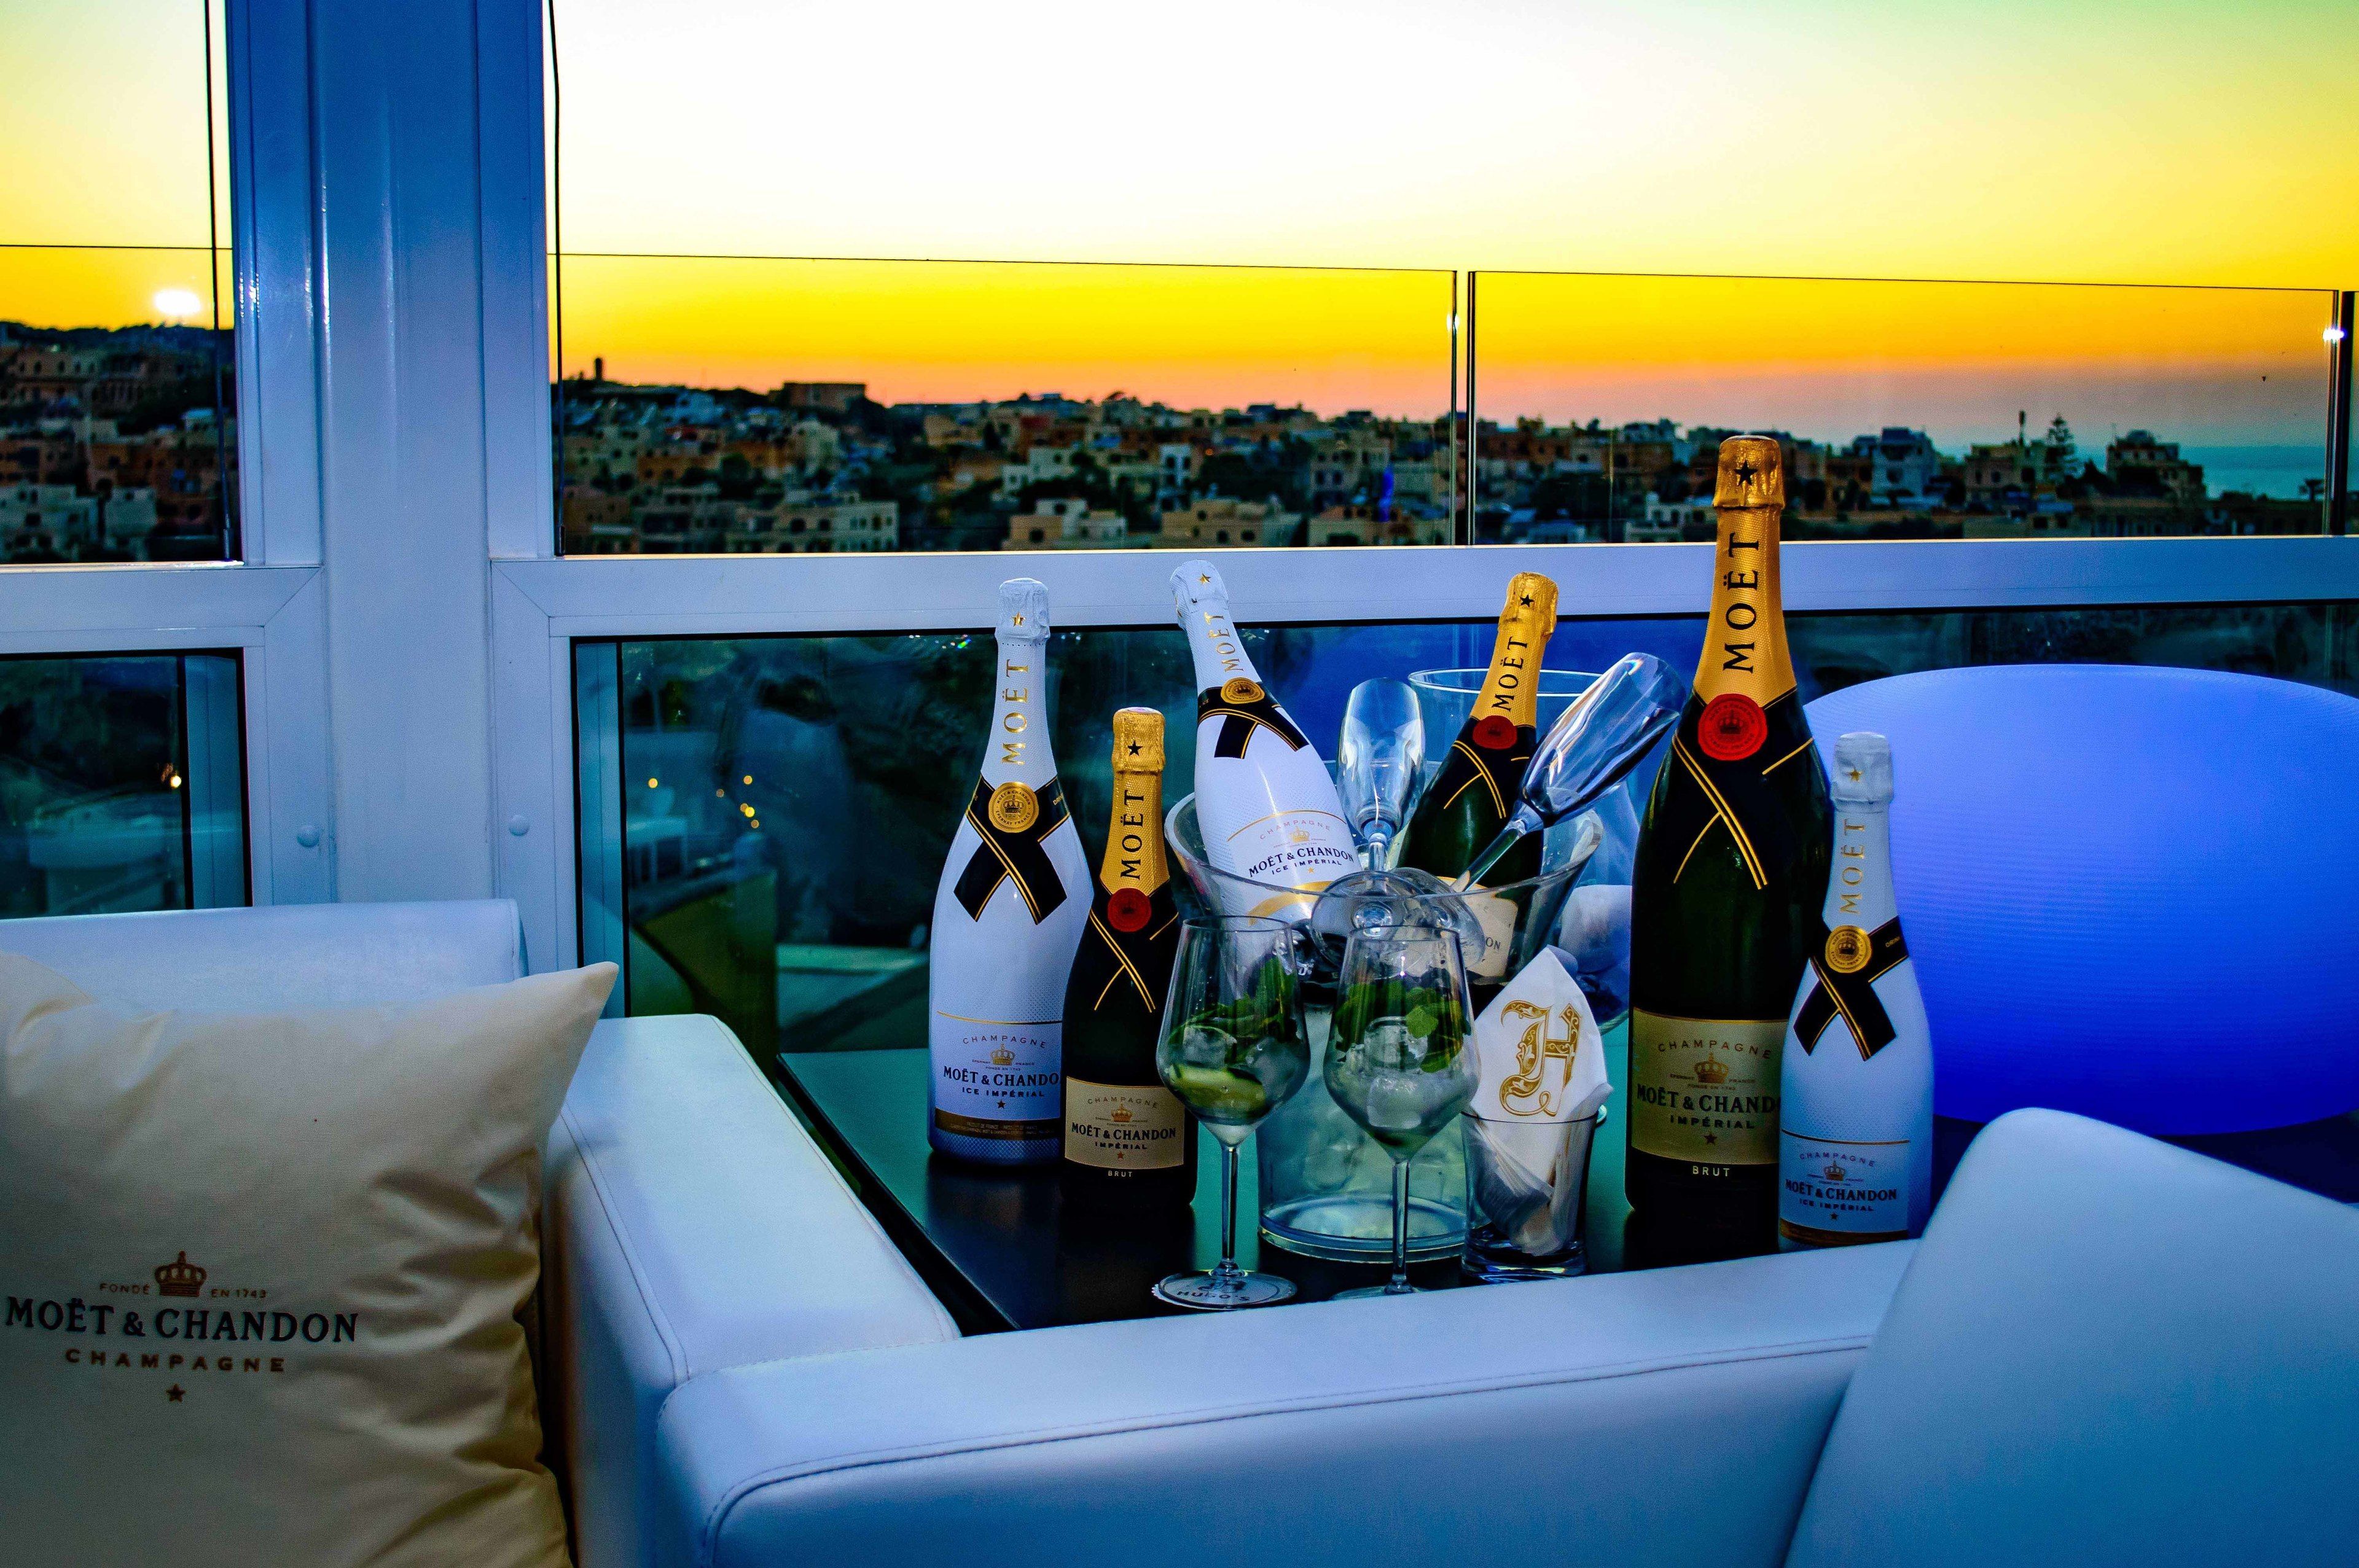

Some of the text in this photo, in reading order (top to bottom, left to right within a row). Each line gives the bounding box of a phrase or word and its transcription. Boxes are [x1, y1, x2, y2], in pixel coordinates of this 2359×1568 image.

[1723, 532, 1759, 674] MOËT
[1203, 612, 1244, 673] MOËT
[1492, 636, 1528, 712] MOËT
[1001, 658, 1029, 765] MOËT
[1121, 789, 1144, 880] MOËT
[1260, 819, 1331, 840] CHAMPAGNE
[1248, 847, 1354, 877] MOËT & CHANDON
[1272, 858, 1342, 875] ICE IMPÉRIAL
[1839, 818, 1865, 915] MOËT
[963, 1034, 1047, 1048] CHAMPAGNE
[1659, 1039, 1771, 1059] CHAMPAGNE
[944, 1065, 1060, 1086] MOËT & CHANDO
[962, 1086, 1045, 1098] ICE IMPÉRIAL
[1637, 1083, 1780, 1114] MOËT & CHAND
[1087, 1096, 1158, 1109] CHAMPAGNE
[1071, 1121, 1176, 1141] MOËT & CHANDON
[1670, 1115, 1755, 1129] IMPÉRIAL
[1095, 1141, 1148, 1150] IMPÉRIAL
[1799, 1152, 1874, 1167] CHAMPAGNE
[1692, 1165, 1730, 1177] BRUT
[1815, 1188, 1823, 1198] &
[1825, 1187, 1897, 1201] CHANDON
[99, 1282, 150, 1295] FONDÉ
[211, 1289, 230, 1298] EN
[6, 1296, 359, 1343] MOËT & CHANDON
[65, 1348, 286, 1372] CHAMPAGNE
